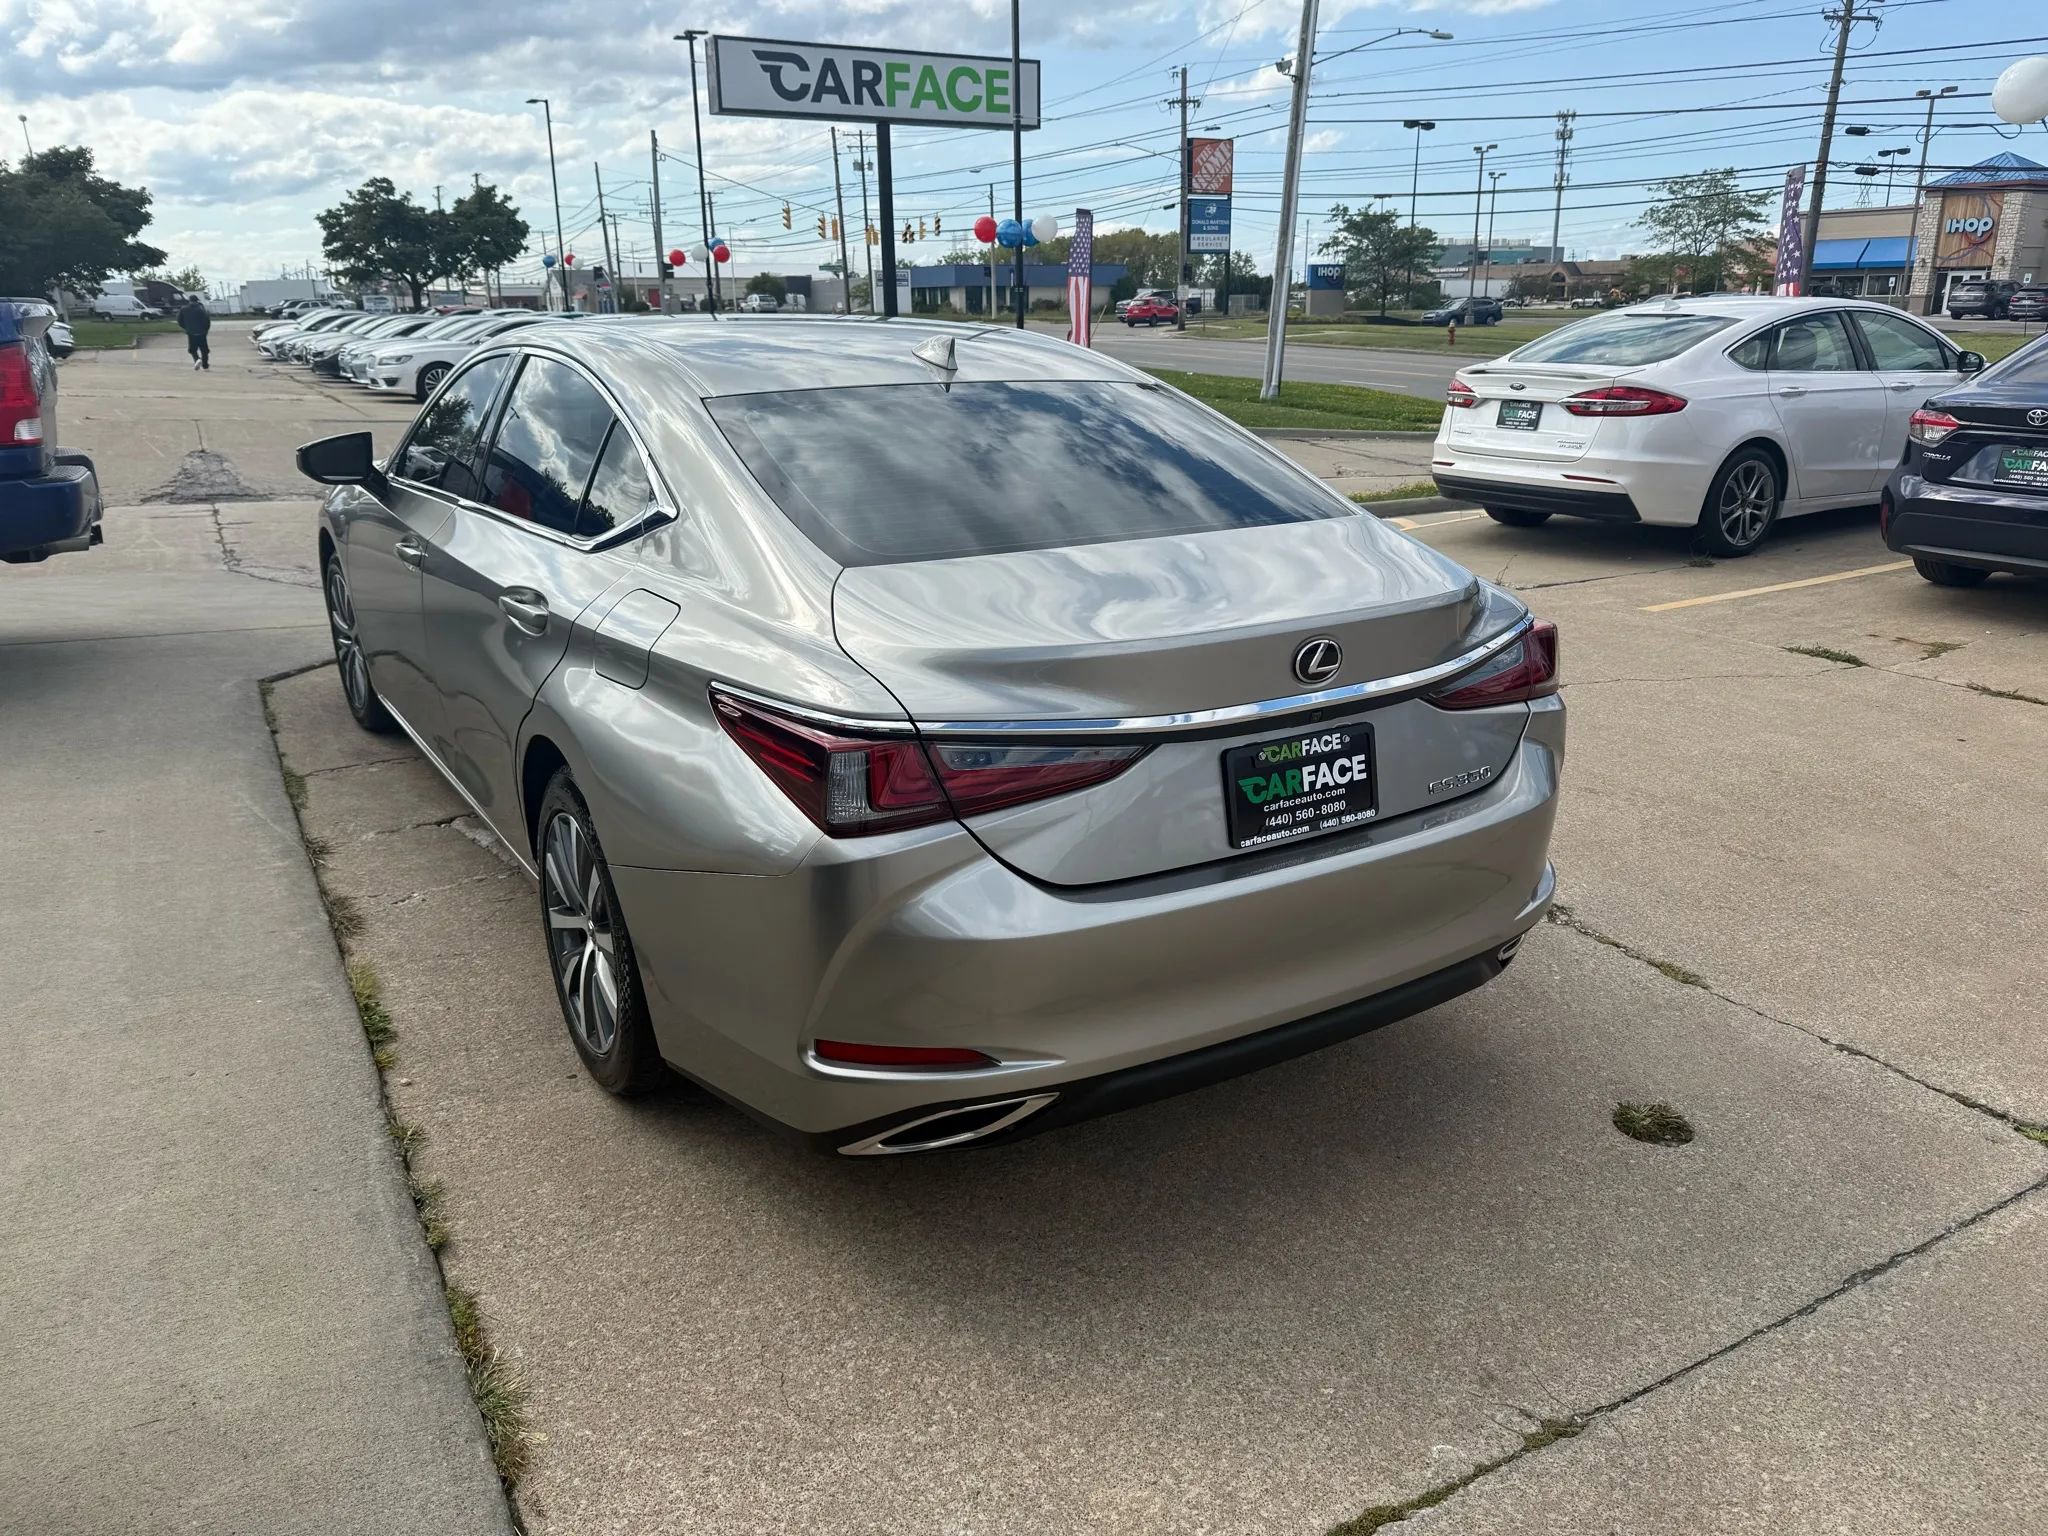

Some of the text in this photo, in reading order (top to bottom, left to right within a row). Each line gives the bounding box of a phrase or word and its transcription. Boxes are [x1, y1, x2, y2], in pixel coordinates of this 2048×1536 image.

[752, 50, 1010, 113] CARFACE
[1192, 141, 1232, 192] HOME
[1946, 217, 1993, 236] IHOP
[1318, 267, 1340, 280] IHOP
[2002, 457, 2048, 471] CARFA
[1263, 733, 1341, 762] CARFACE
[1238, 754, 1367, 804] CARFACE
[1263, 787, 1346, 812] carfaceauto.com
[1240, 808, 1375, 848] carfaceauto.com (440) 560-8080
[1266, 812, 1293, 827] (440)
